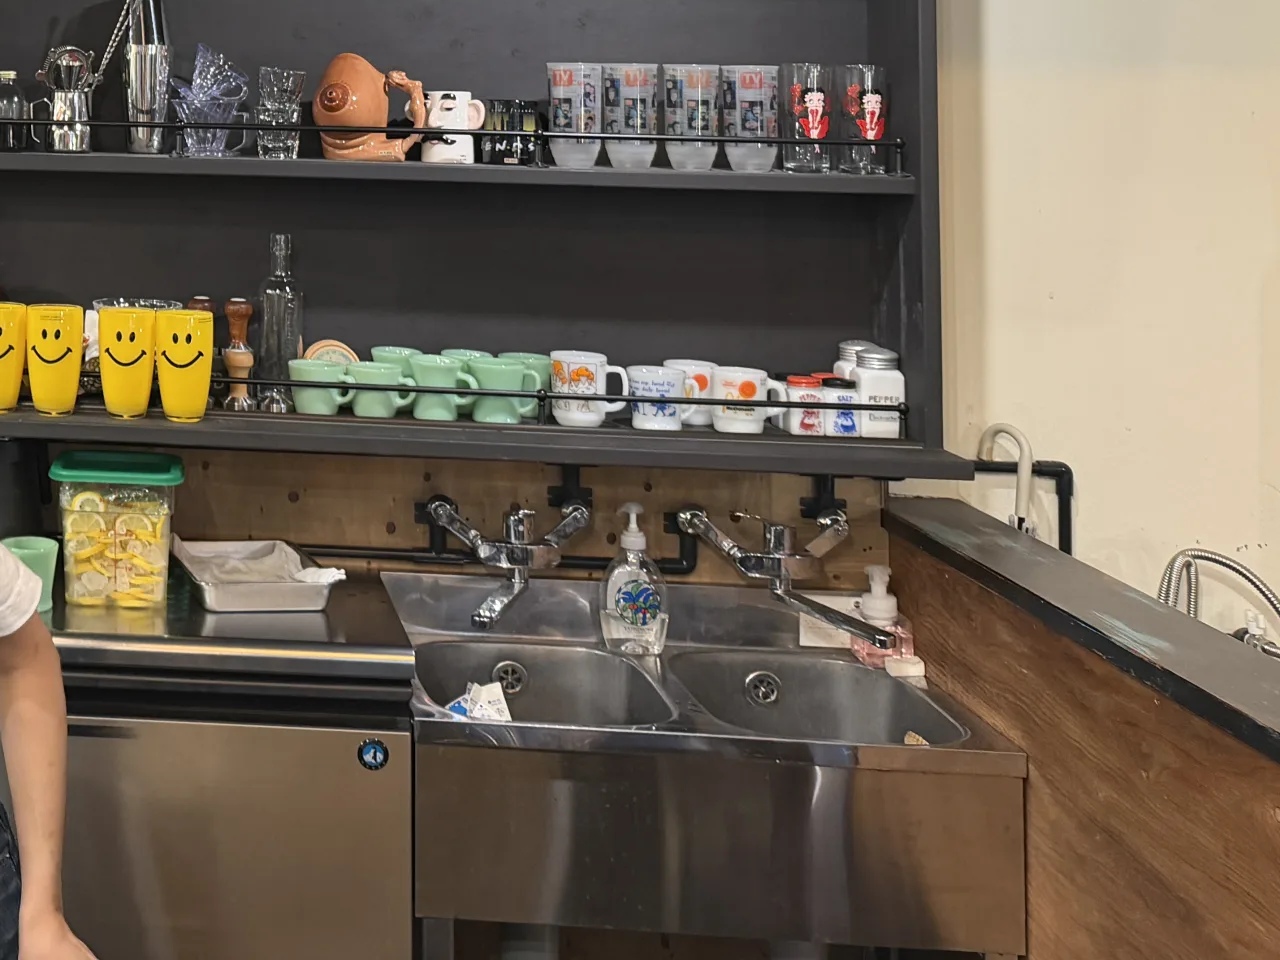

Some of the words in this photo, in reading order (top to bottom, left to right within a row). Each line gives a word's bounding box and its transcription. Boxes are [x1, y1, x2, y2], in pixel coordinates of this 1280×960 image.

[555, 70, 570, 84] TV
[743, 73, 761, 86] TV
[837, 395, 854, 403] SALT
[868, 395, 900, 404] PEPPER
